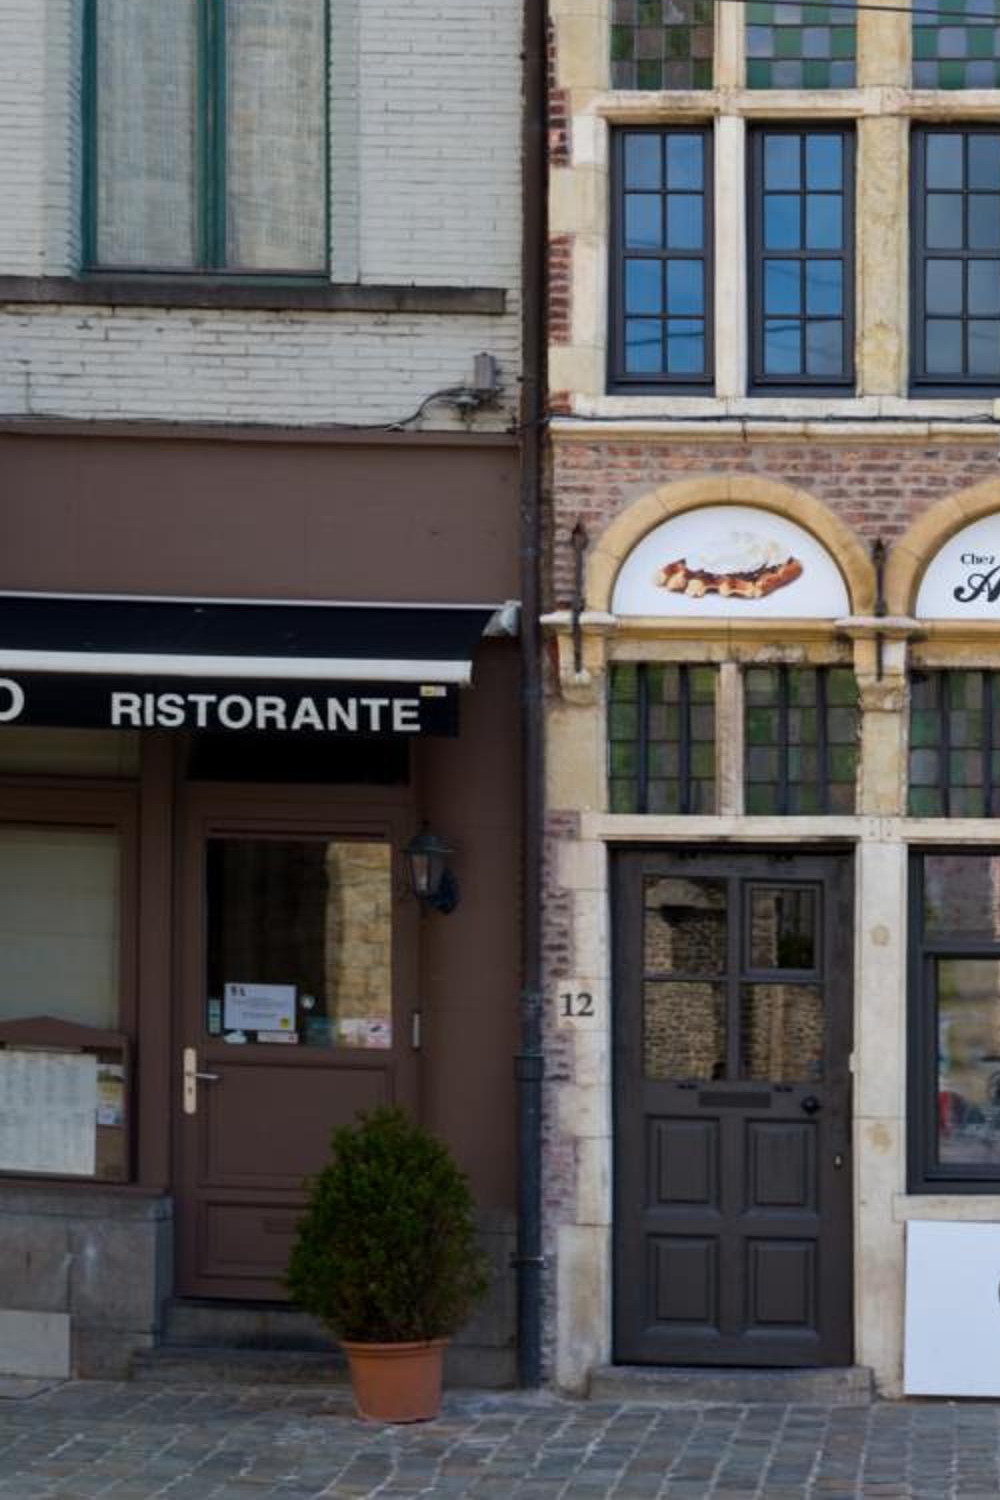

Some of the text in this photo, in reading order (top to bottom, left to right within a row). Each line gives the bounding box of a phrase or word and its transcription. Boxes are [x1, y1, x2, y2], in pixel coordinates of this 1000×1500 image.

[960, 553, 995, 565] Chez
[110, 692, 421, 731] RISTORANTE
[559, 993, 594, 1017] 12
